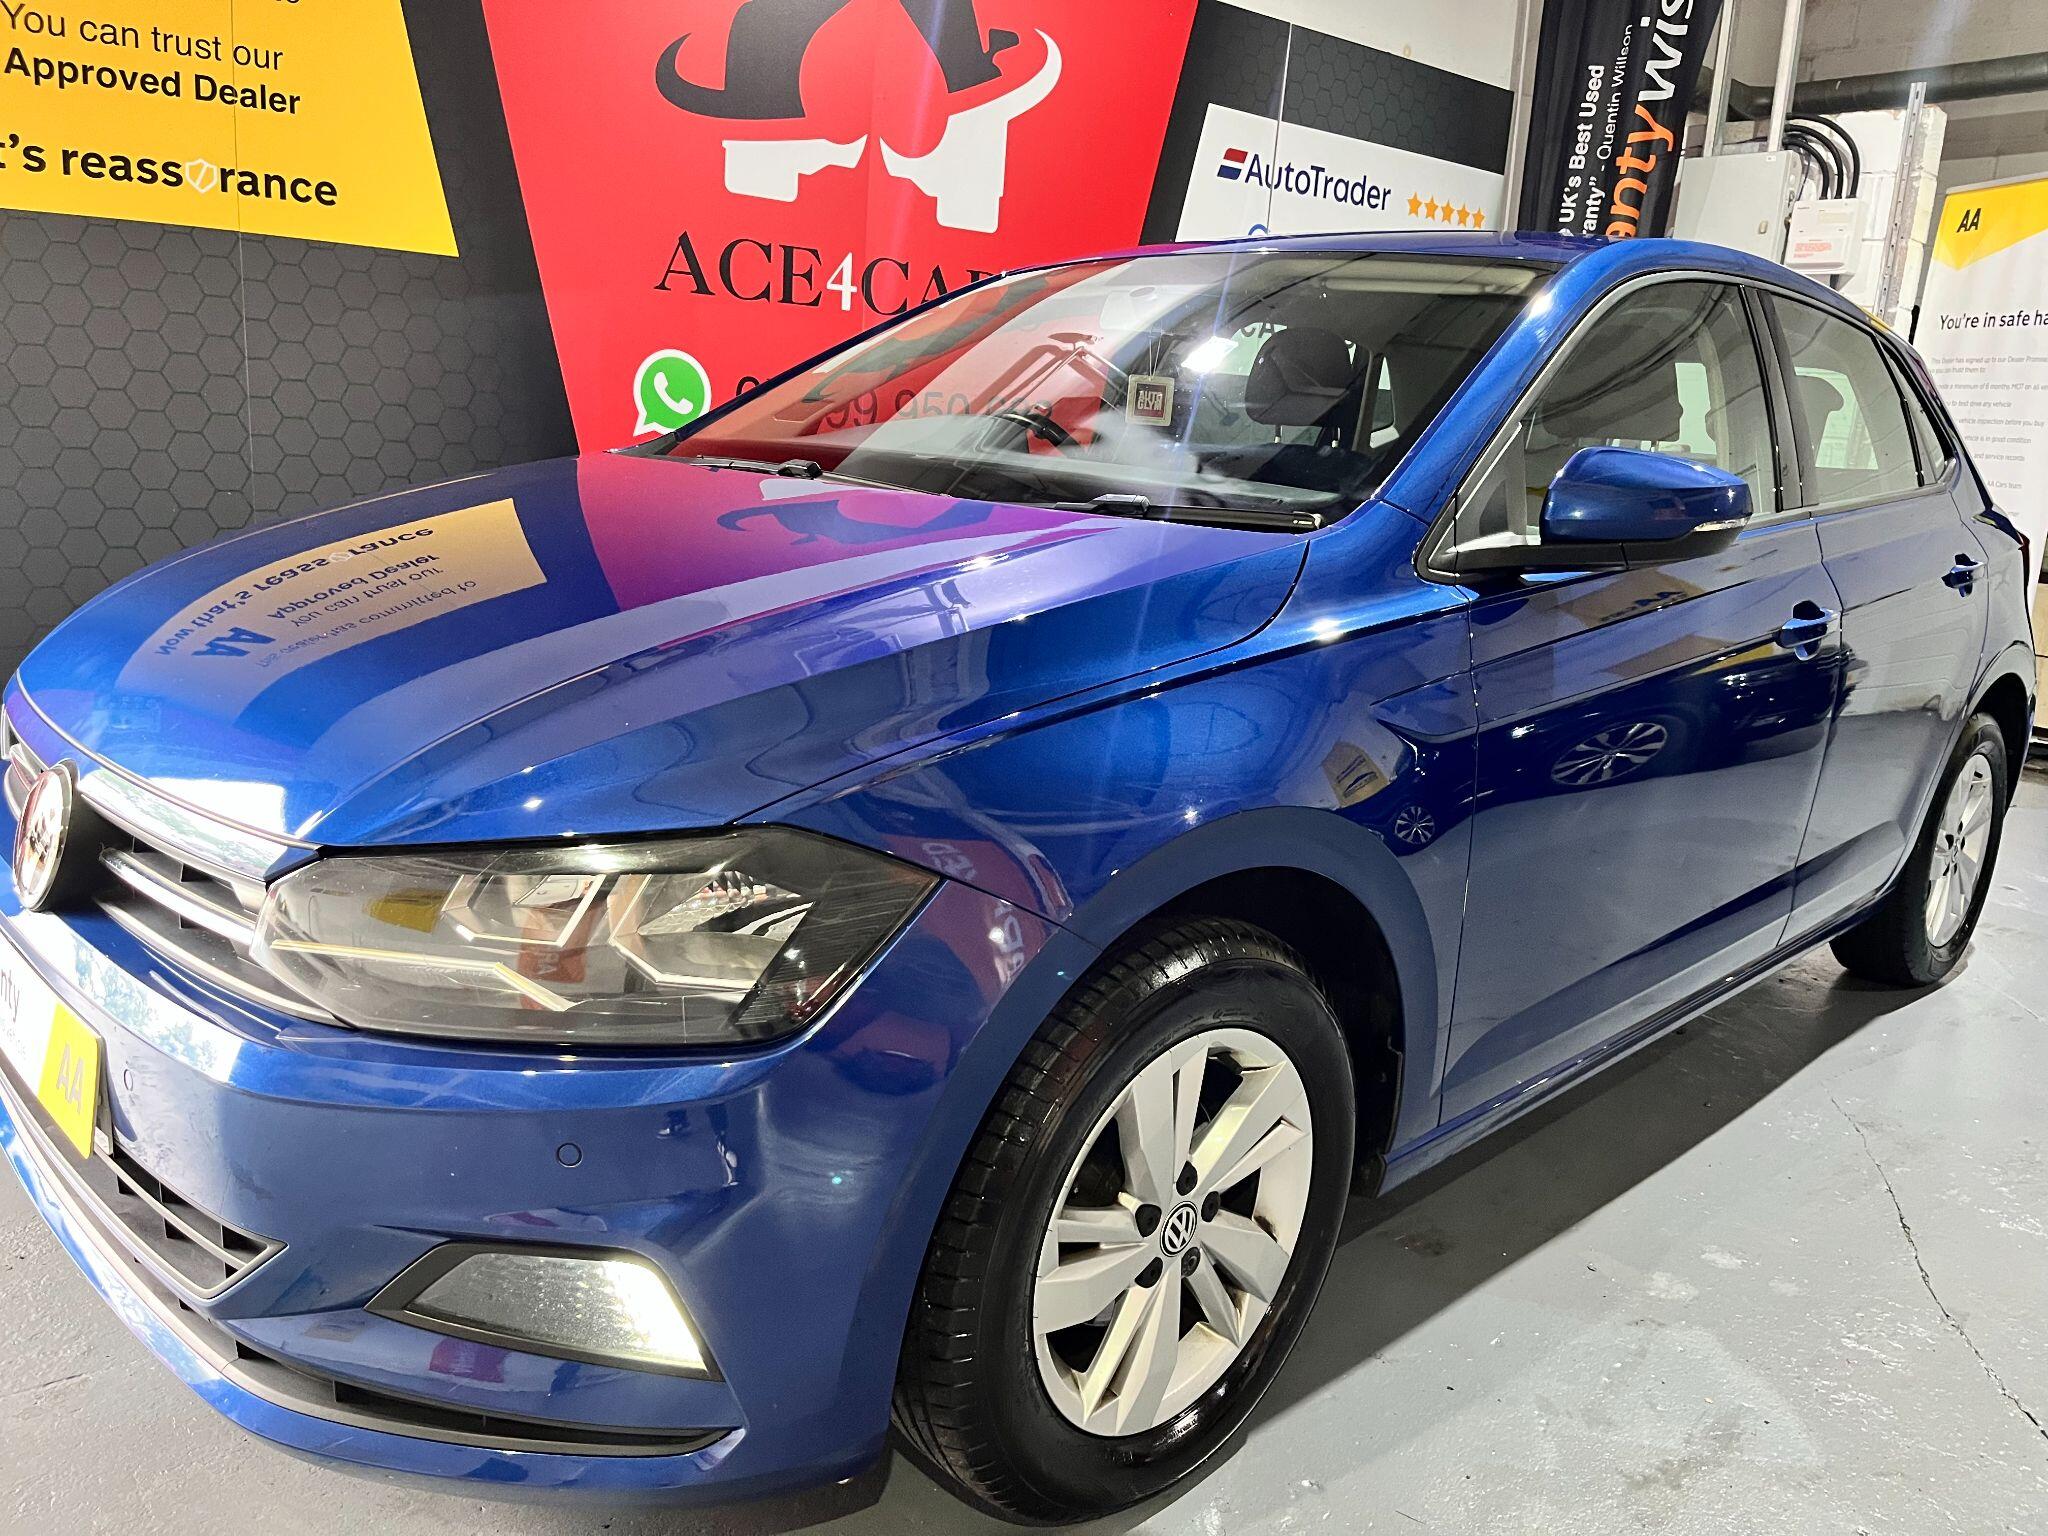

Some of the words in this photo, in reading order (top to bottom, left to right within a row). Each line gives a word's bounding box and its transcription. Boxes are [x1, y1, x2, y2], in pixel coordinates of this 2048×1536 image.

[1, 1, 65, 38] You
[79, 20, 140, 49] can
[151, 26, 222, 61] trust
[232, 44, 283, 71] our
[4, 47, 181, 98] Approved
[194, 74, 300, 115] Dealer
[1579, 65, 1605, 118] Used
[1569, 123, 1593, 170] Best
[1597, 92, 1621, 160] Quentin
[1245, 153, 1391, 210] AutoTrader
[1957, 208, 1981, 233] AA
[1940, 313, 1979, 330] You're
[1983, 312, 1995, 328] in
[1999, 310, 2030, 327] safe
[56, 1043, 85, 1115] AA
